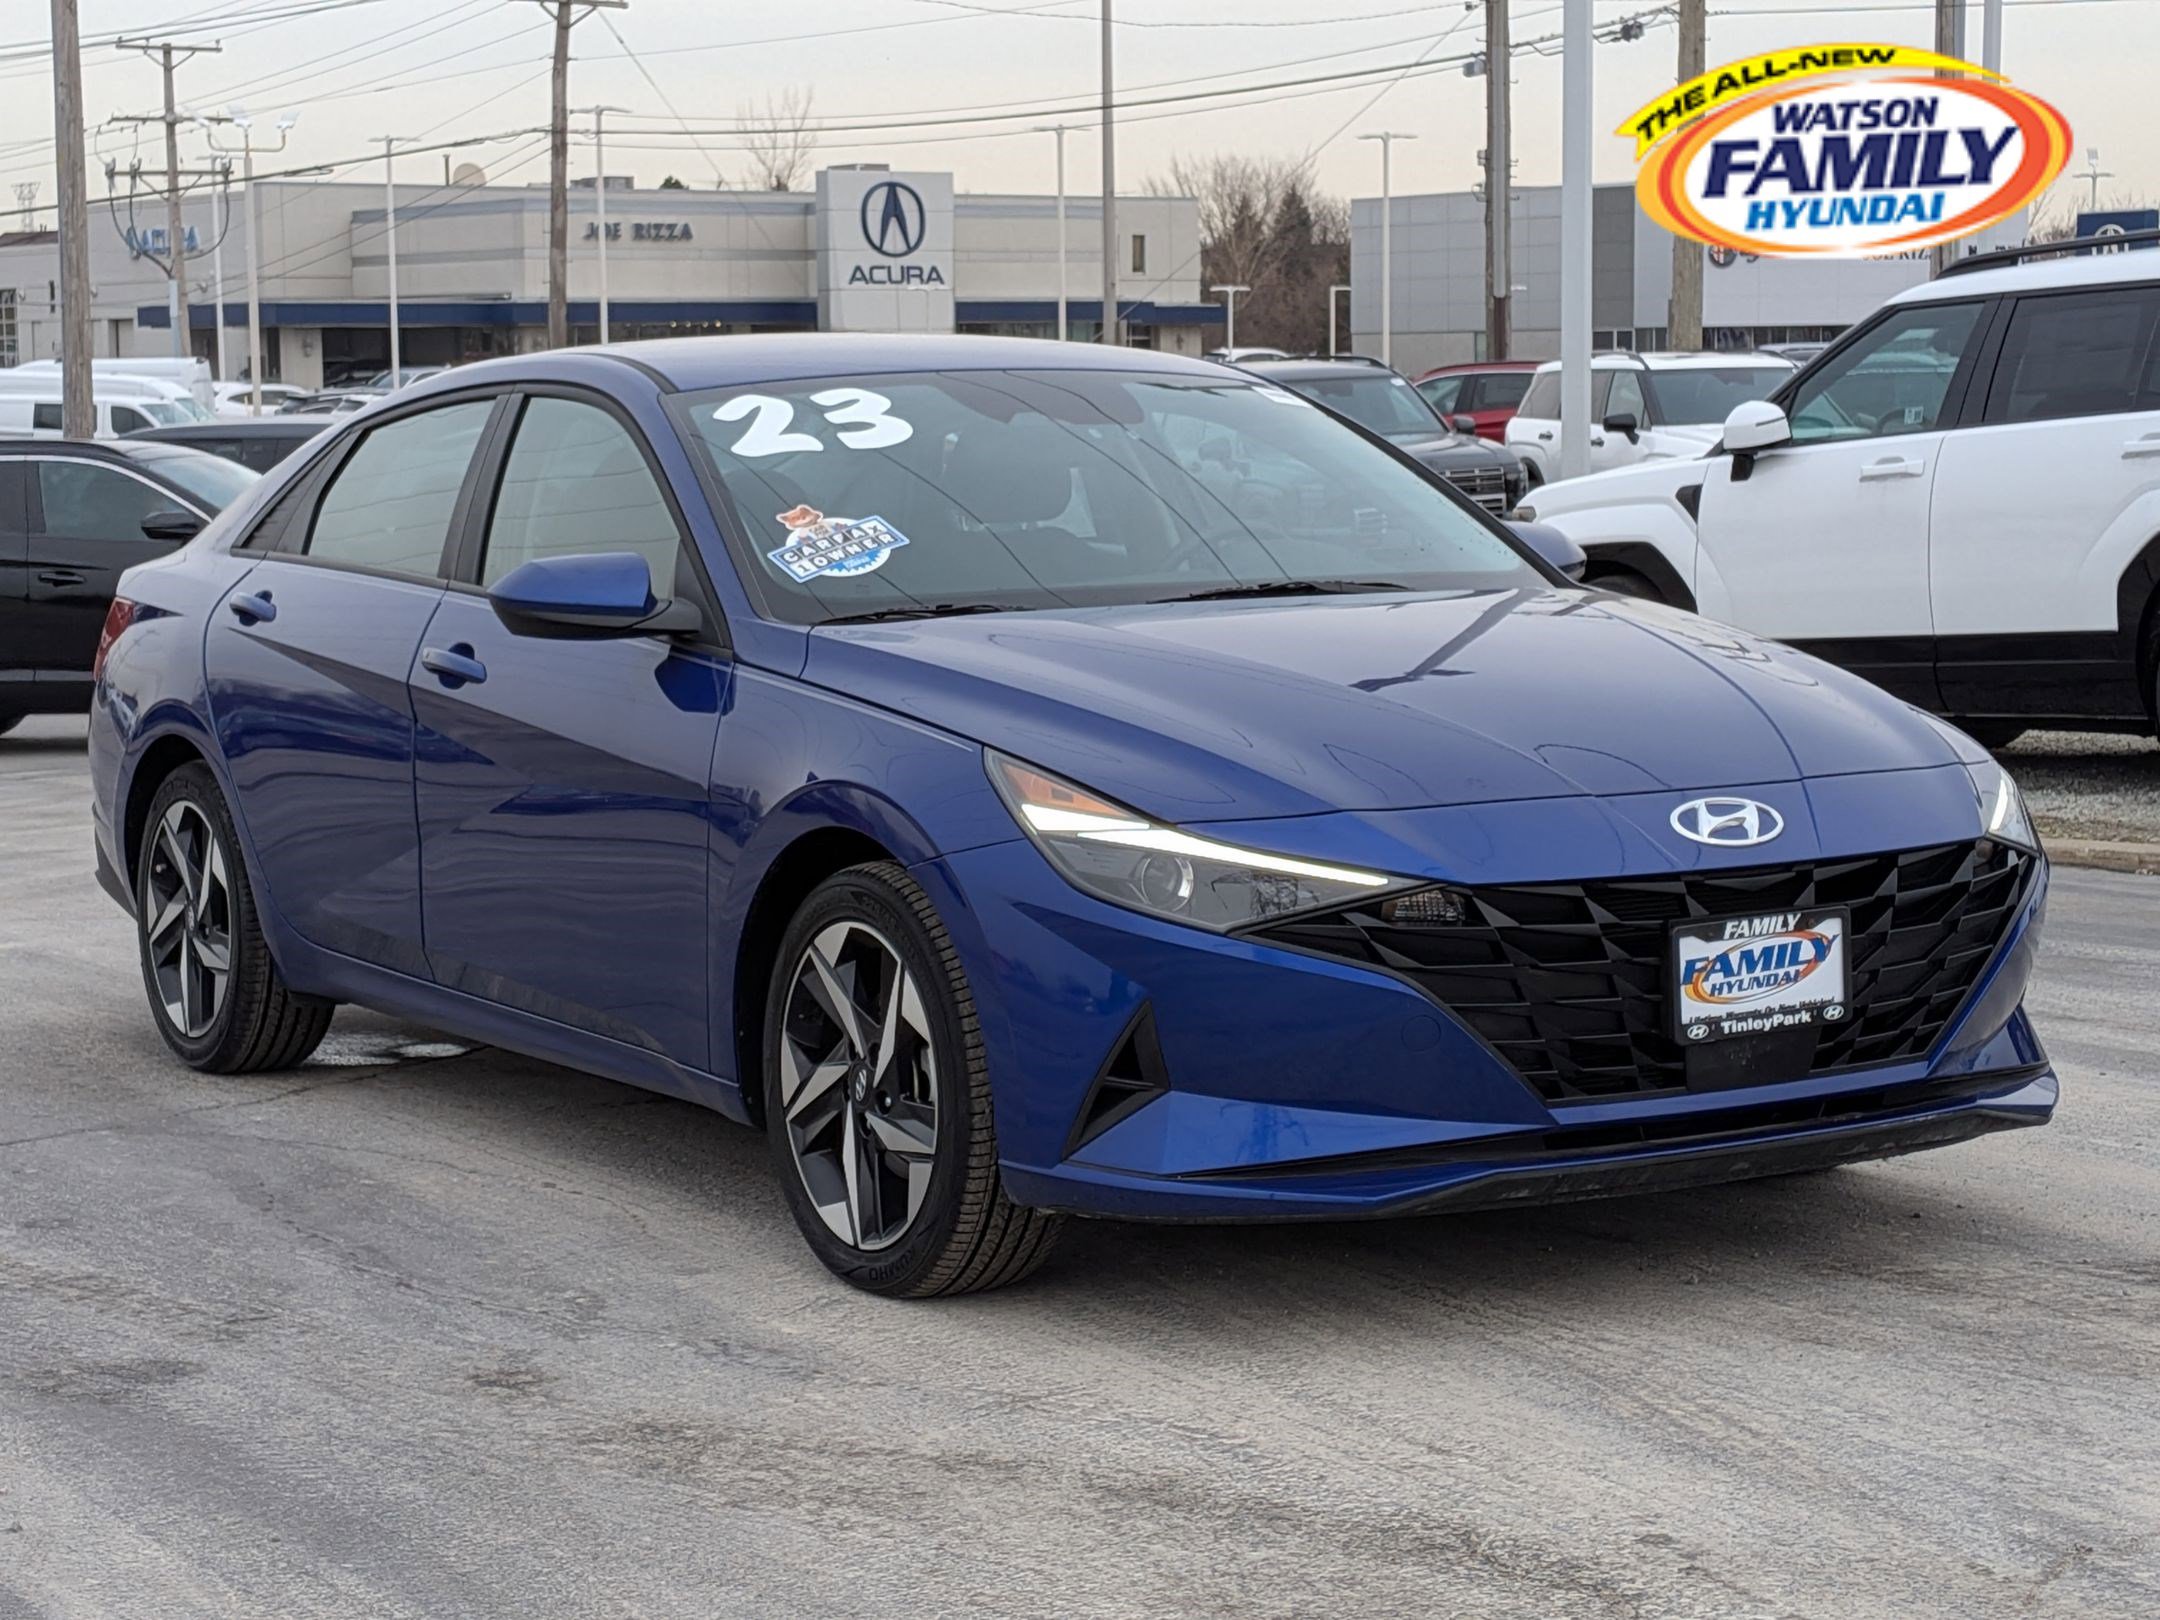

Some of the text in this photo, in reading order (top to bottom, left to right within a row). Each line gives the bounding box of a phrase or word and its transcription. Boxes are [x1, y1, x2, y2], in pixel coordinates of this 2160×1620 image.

[631, 222, 694, 241] RIZZA
[848, 265, 946, 286] ACURA
[712, 387, 914, 458] 23
[782, 525, 883, 565] CARFAX
[812, 533, 895, 568] OWNER
[1723, 912, 1802, 940] FAMILY
[1681, 933, 1841, 986] FAMILY
[1708, 968, 1802, 997] HYUNDAI
